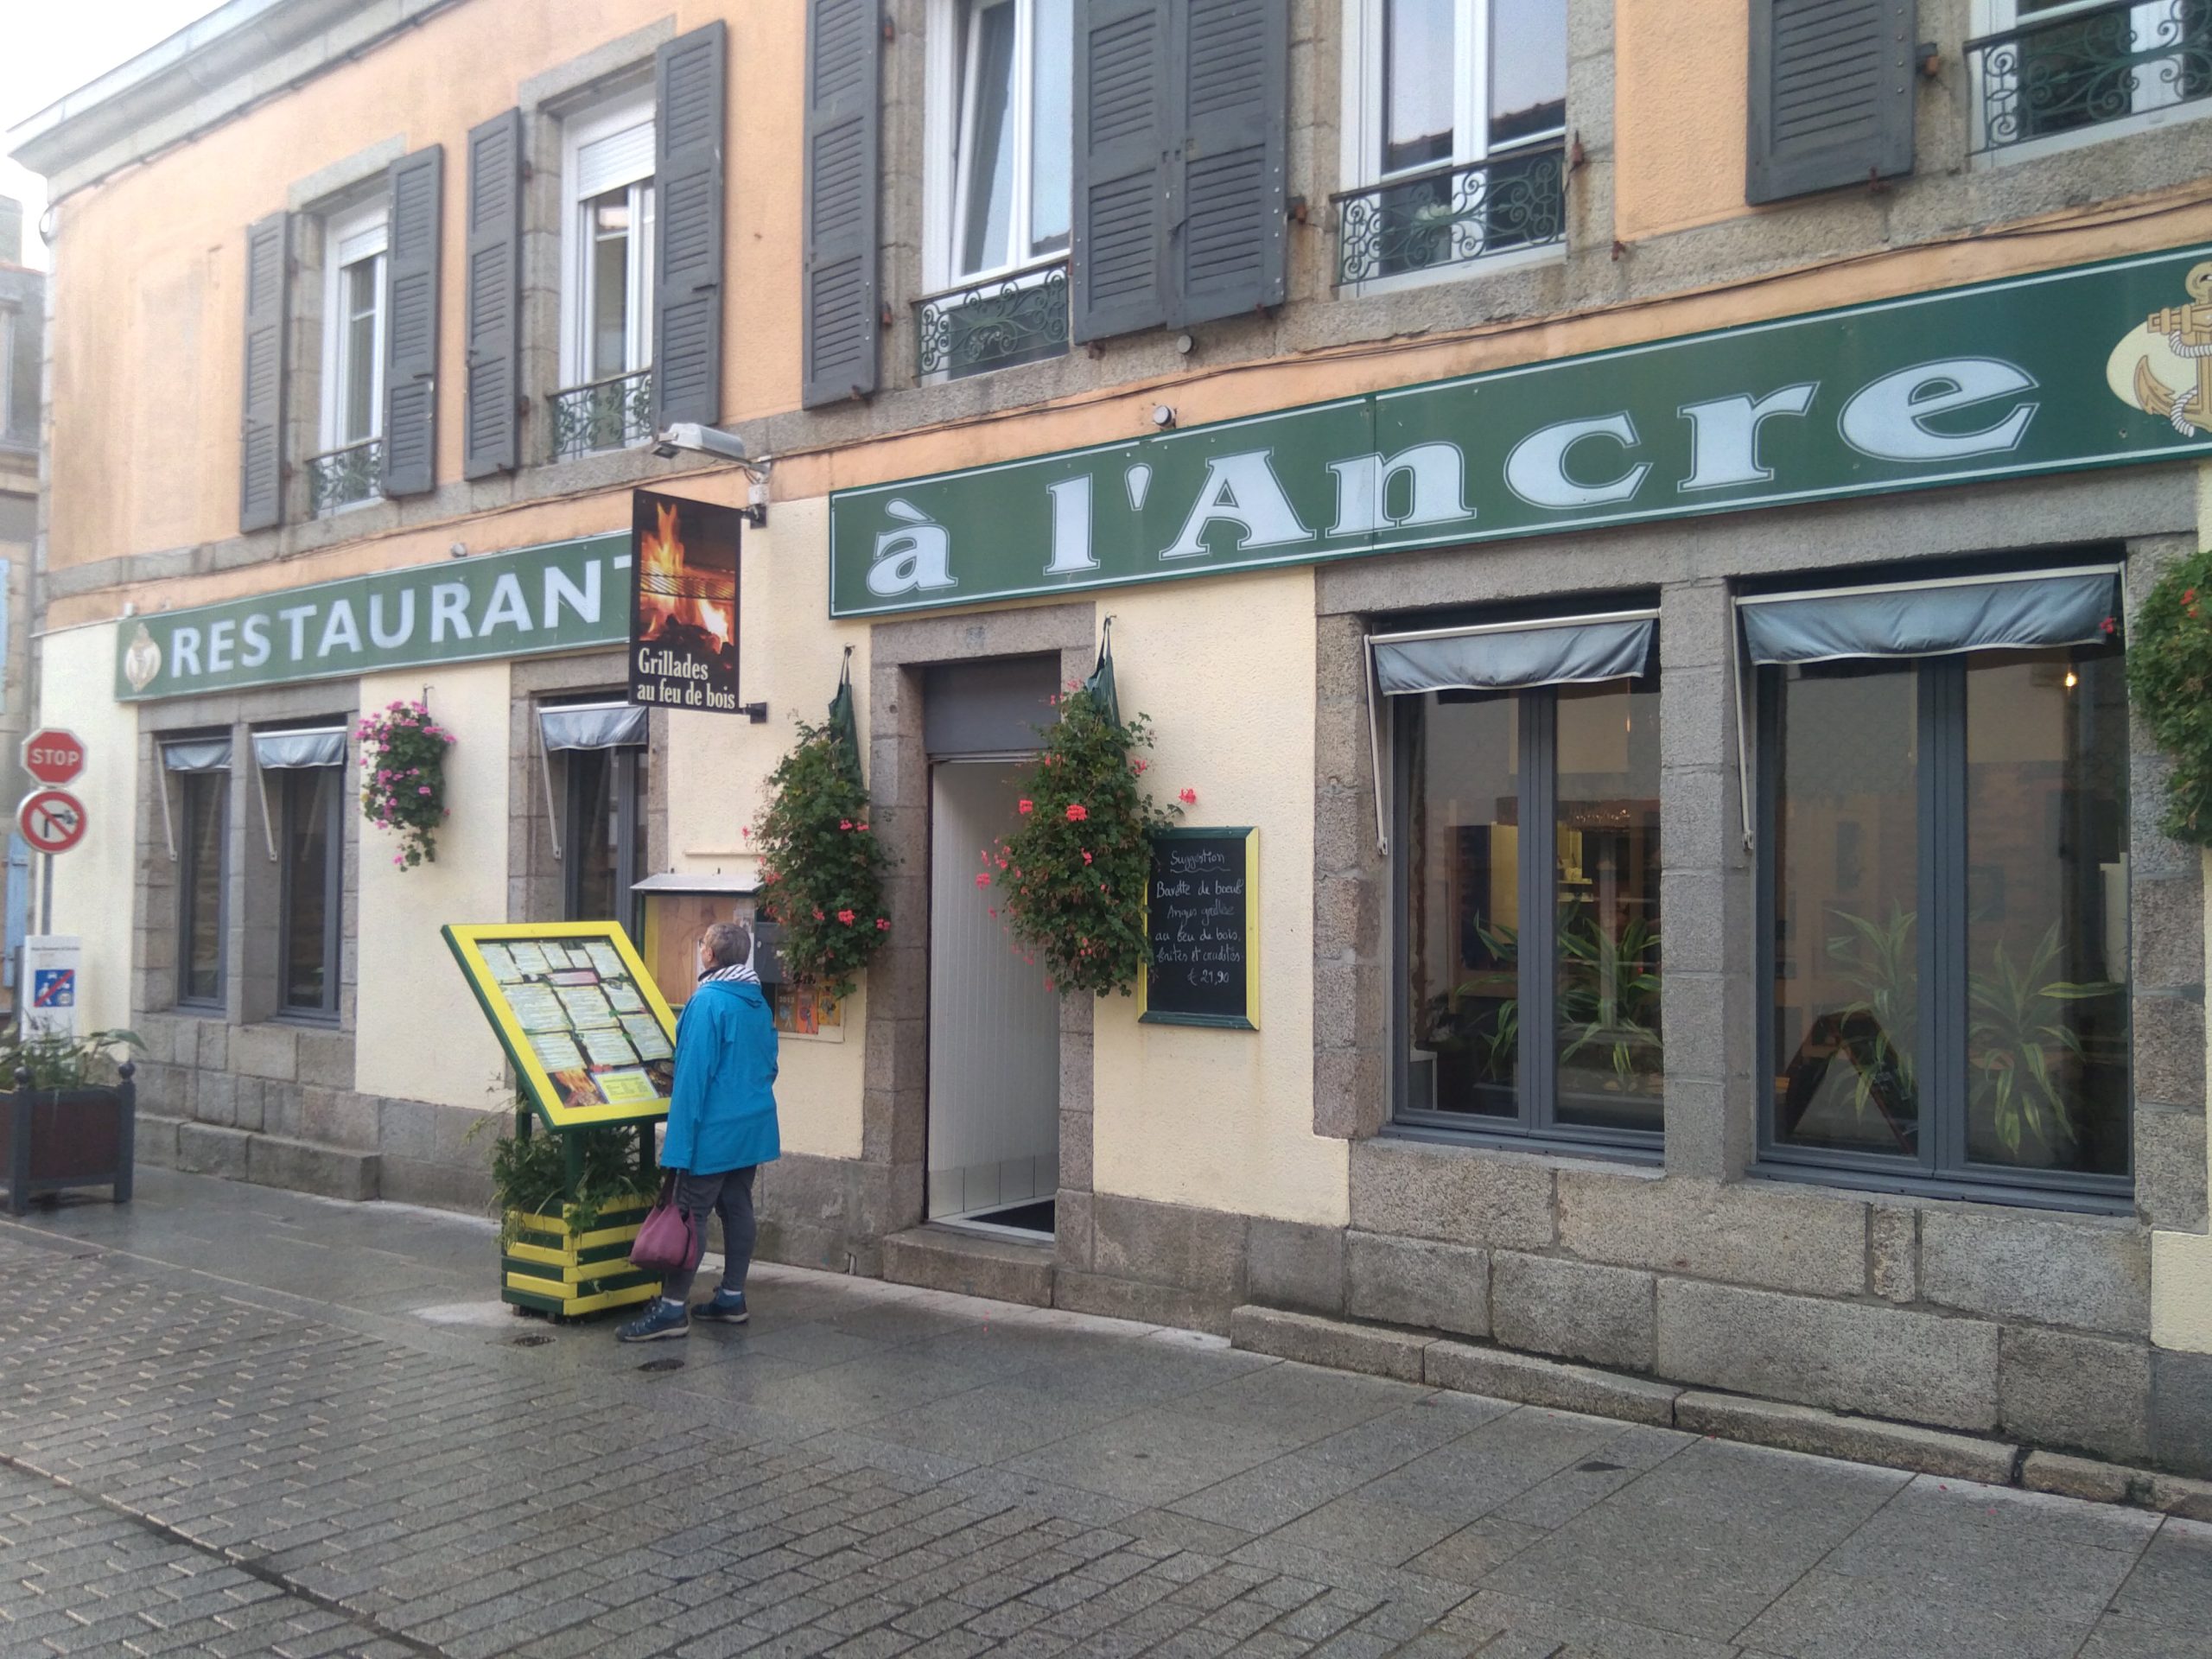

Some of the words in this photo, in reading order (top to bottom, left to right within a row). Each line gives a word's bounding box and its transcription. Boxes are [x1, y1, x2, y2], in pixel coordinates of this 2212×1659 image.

[866, 498, 957, 600] à
[1043, 355, 2041, 577] l'Ancre
[638, 646, 709, 681] Grillades
[637, 683, 655, 702] au
[658, 677, 681, 704] feu
[685, 681, 702, 707] de
[706, 683, 735, 709] bois
[31, 748, 79, 766] STOP
[1198, 880, 1211, 896] de
[1155, 931, 1170, 942] au
[1177, 923, 1195, 944] feu
[1199, 928, 1212, 942] de
[1191, 948, 1201, 963] et
